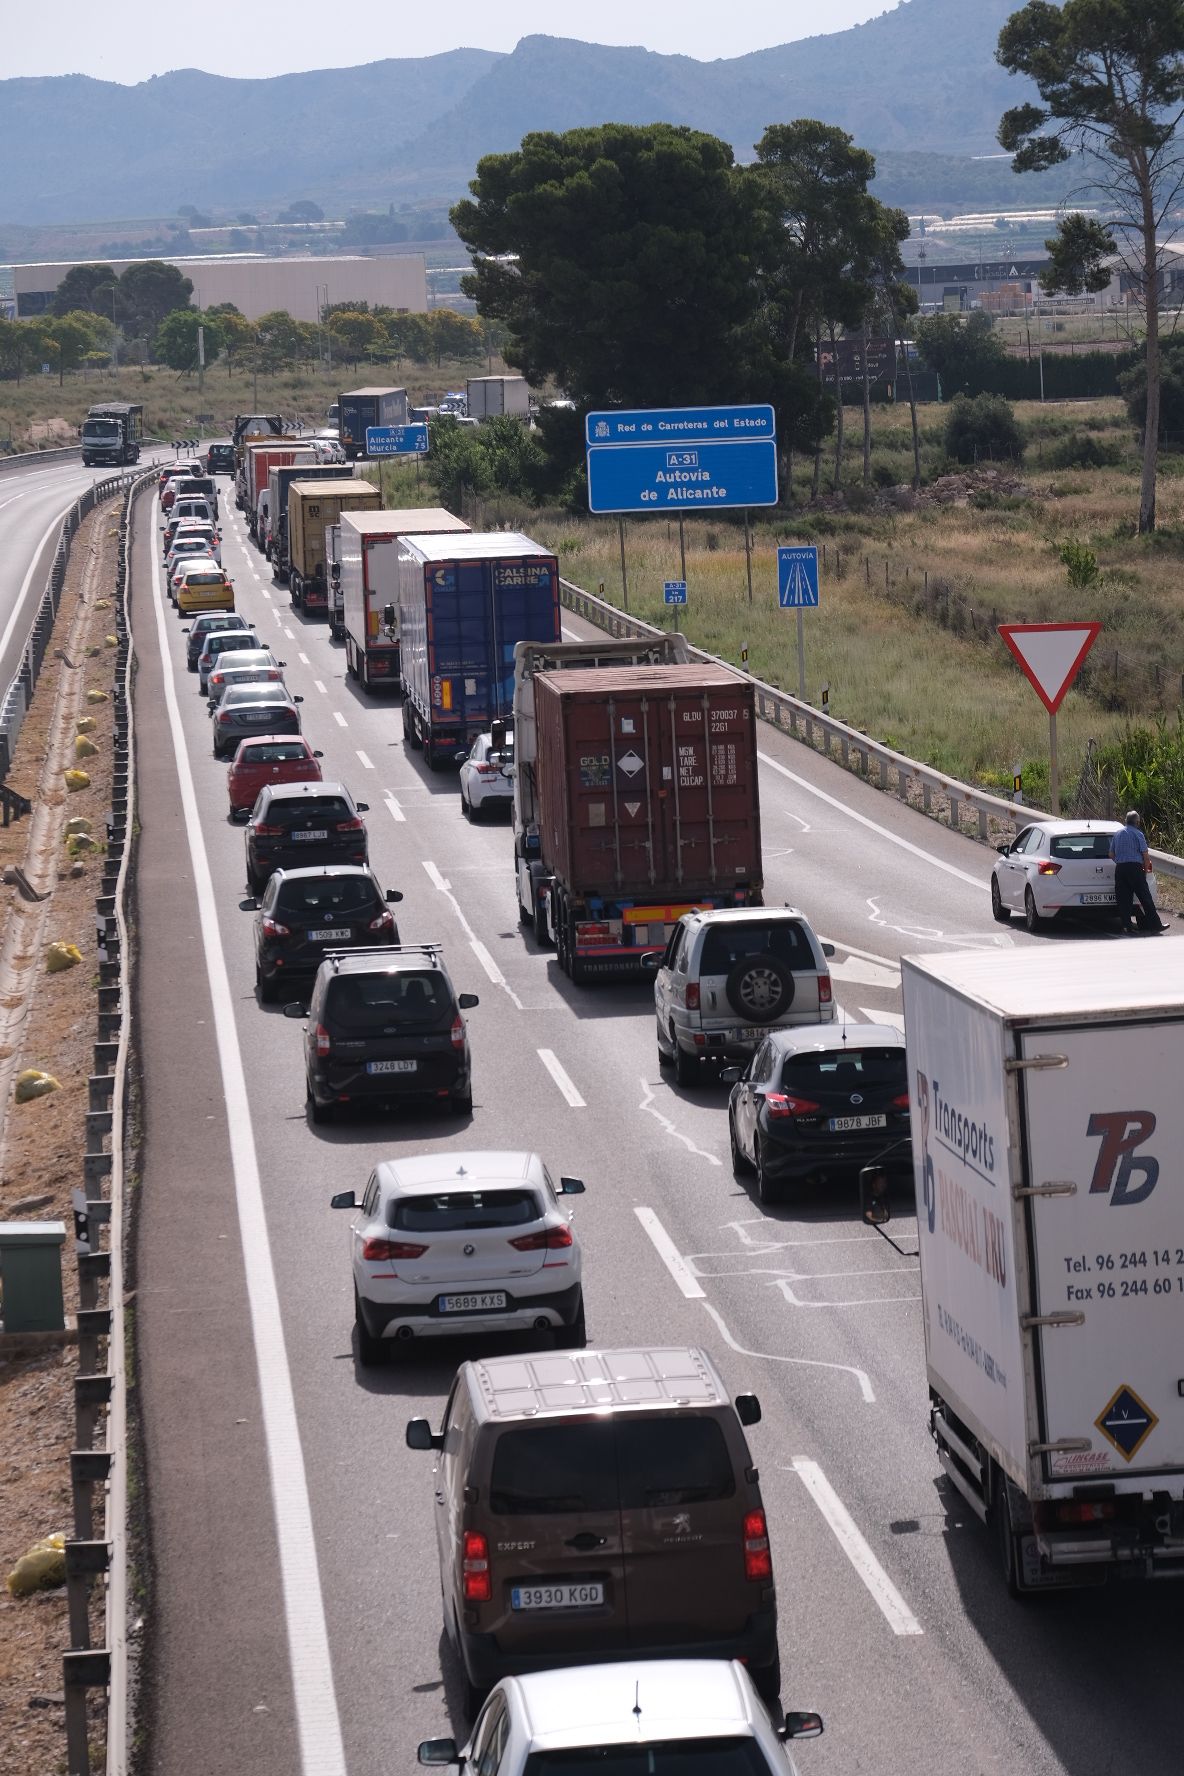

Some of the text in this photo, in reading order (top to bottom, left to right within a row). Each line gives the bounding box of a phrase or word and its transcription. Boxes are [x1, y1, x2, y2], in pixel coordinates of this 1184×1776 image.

[617, 418, 766, 432] Red de Carreteras del Estado
[670, 454, 696, 465] A-31
[640, 486, 726, 500] de Alicante
[496, 567, 549, 577] CALSINA
[711, 710, 737, 720] 370037
[712, 723, 728, 732] 22G1
[580, 756, 609, 766] GOLD
[374, 1062, 395, 1071] 3248
[837, 1116, 882, 1129] 9878 JBF
[933, 1080, 994, 1172] Transports
[1064, 1256, 1091, 1273] Tel.
[1096, 1254, 1114, 1271] 96
[1120, 1251, 1147, 1269] 244
[1153, 1250, 1170, 1266] 14
[1066, 1285, 1093, 1301] Fax
[1097, 1282, 1115, 1298] 96
[1120, 1280, 1148, 1296] 244
[1154, 1278, 1171, 1294] 60
[448, 1295, 503, 1310] 5689 KXS
[498, 1541, 536, 1551] EXPERT
[523, 1587, 598, 1605] 3930 KGD
